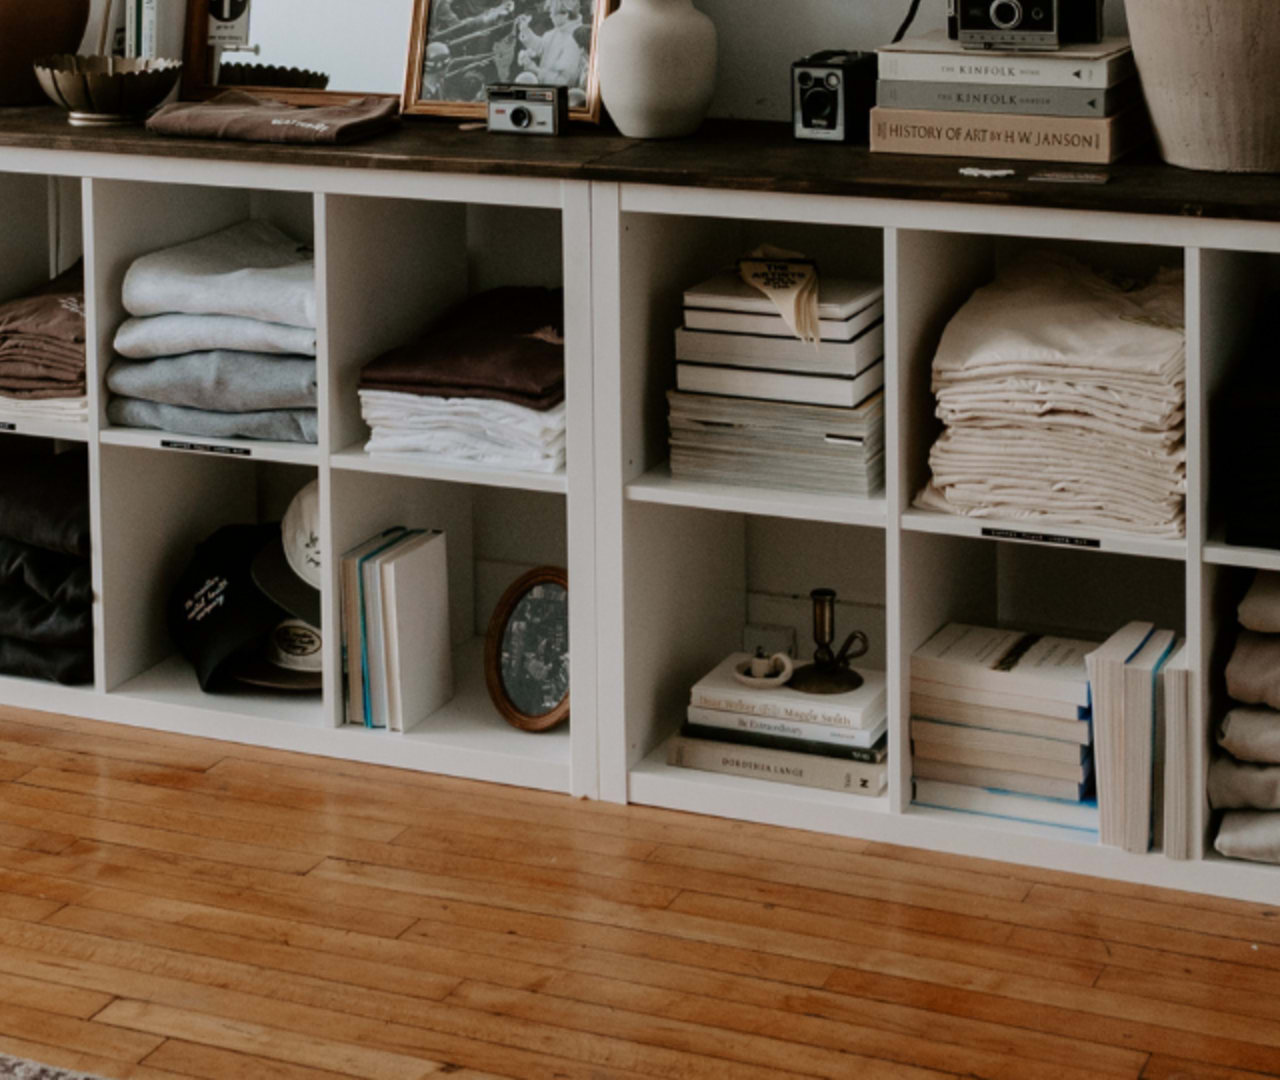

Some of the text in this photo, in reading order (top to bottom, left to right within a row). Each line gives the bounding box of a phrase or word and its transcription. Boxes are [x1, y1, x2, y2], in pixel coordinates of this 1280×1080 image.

[959, 65, 1016, 77] KINFOLK
[956, 92, 1017, 106] KINFOLK
[889, 124, 943, 140] HISTORY
[945, 127, 962, 140] OF
[964, 128, 988, 142] ART
[1004, 131, 1015, 143] H
[1035, 132, 1093, 149] JANSON
[773, 764, 804, 778] LANGE
